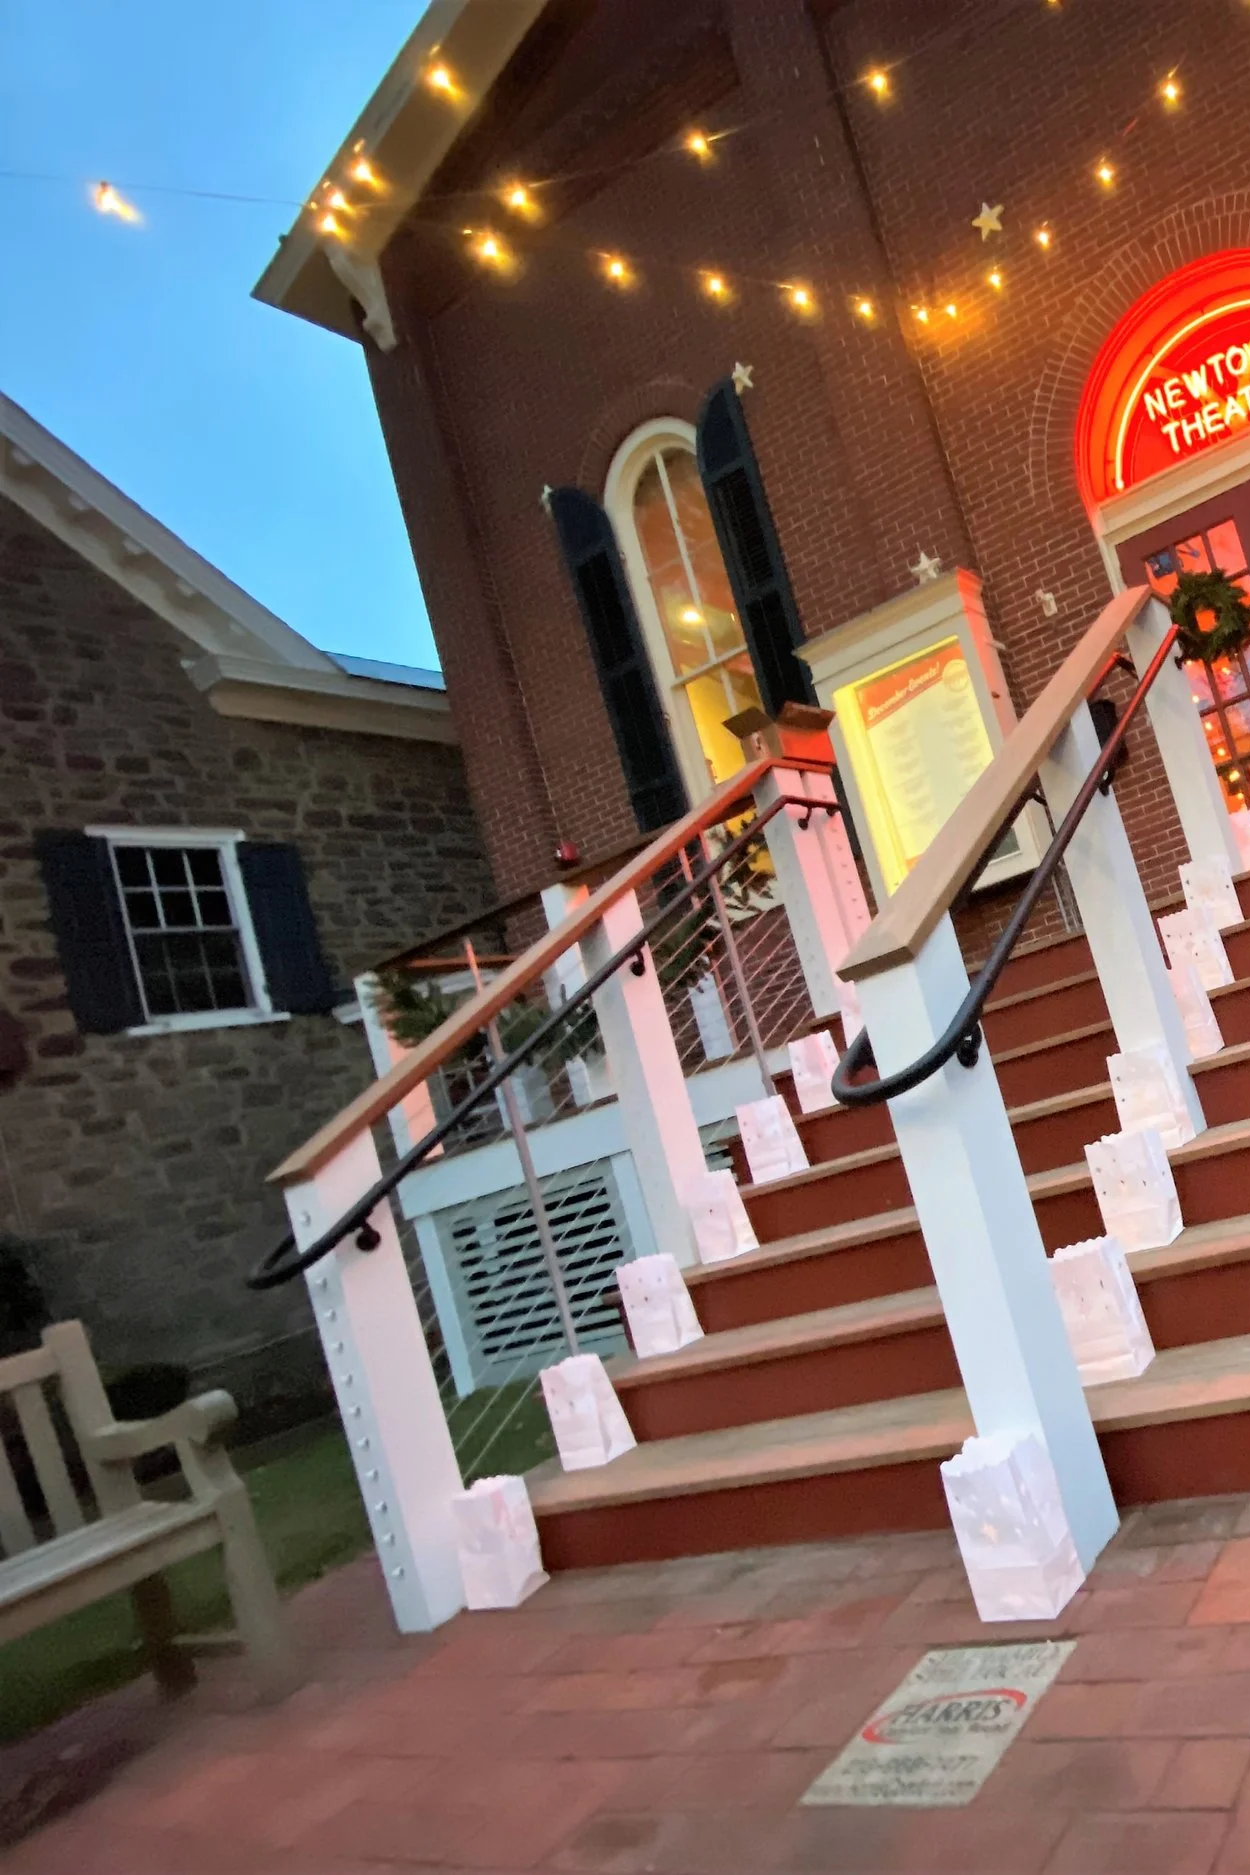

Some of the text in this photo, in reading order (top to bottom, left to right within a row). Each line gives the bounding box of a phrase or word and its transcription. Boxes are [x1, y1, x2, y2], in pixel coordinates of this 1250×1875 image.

[867, 687, 908, 721] December
[908, 661, 940, 691] Events!
[892, 1700, 1009, 1724] HARRIS
